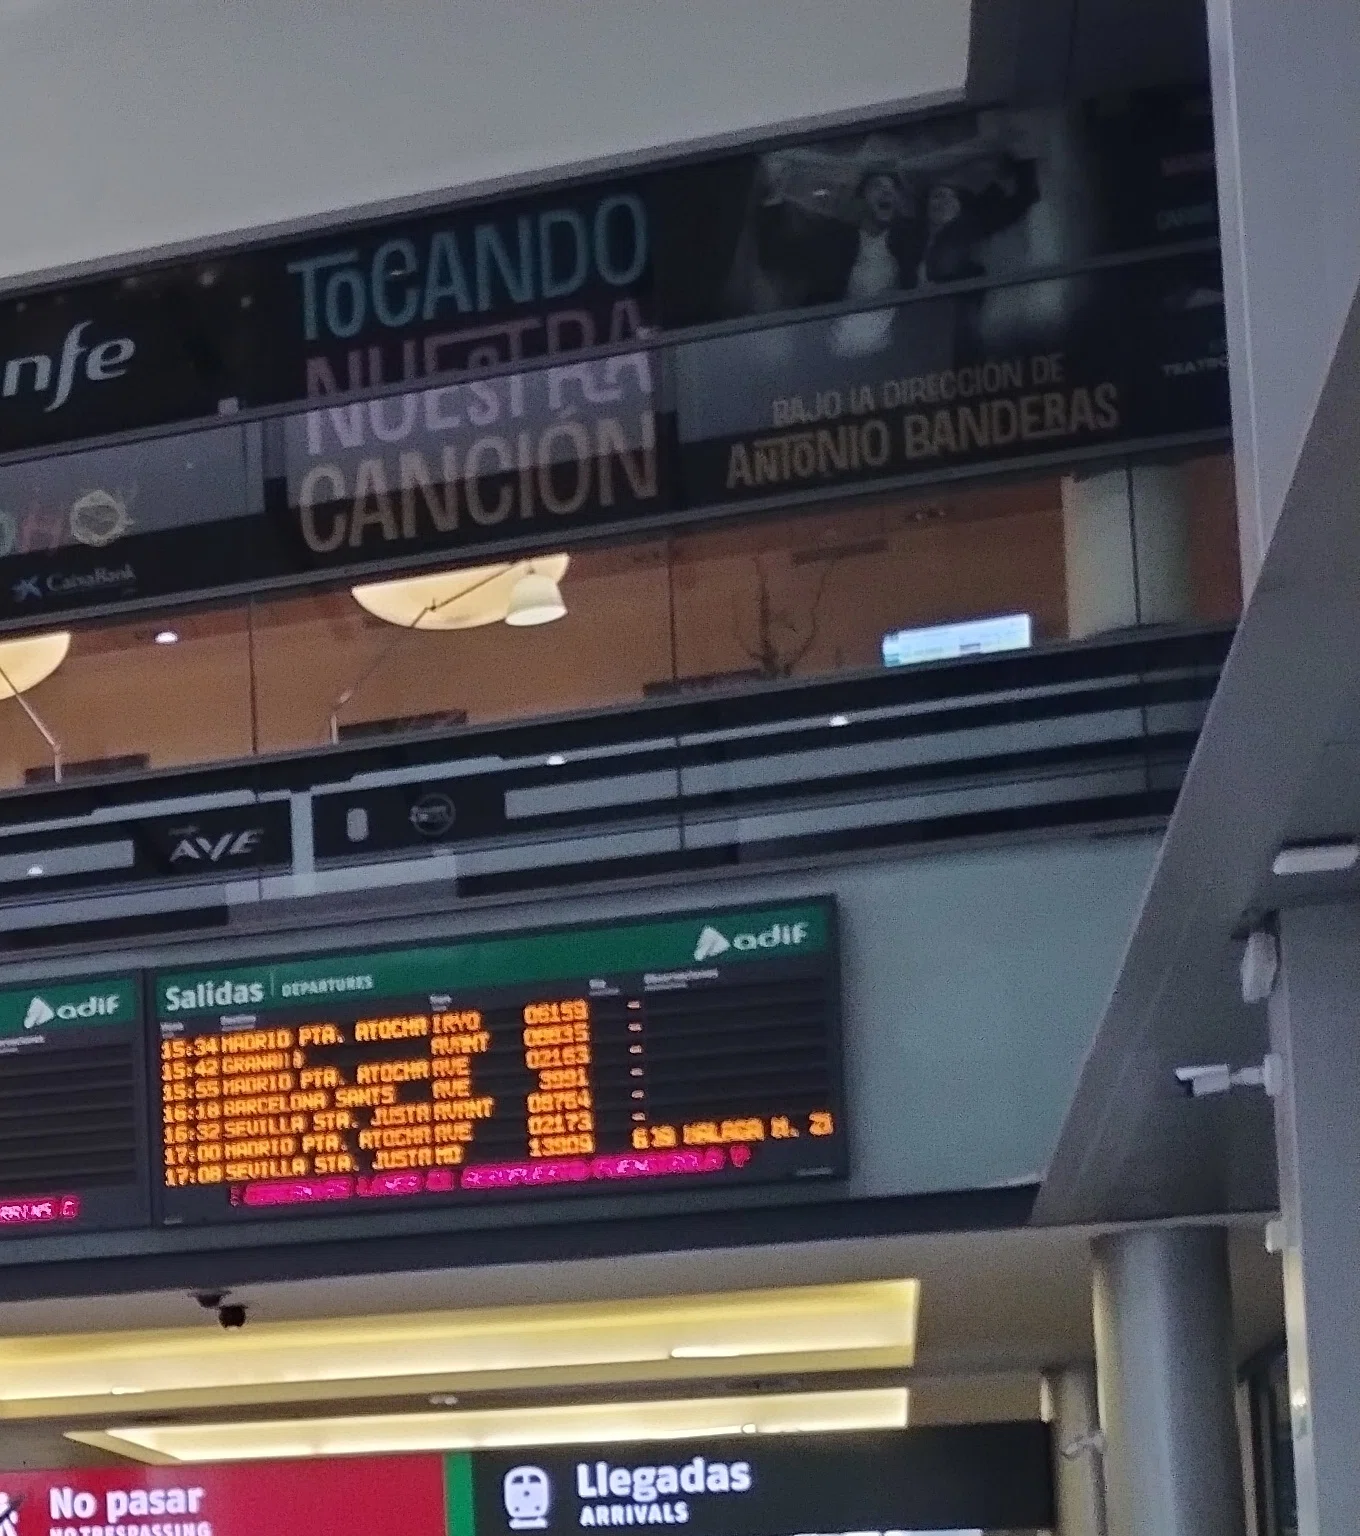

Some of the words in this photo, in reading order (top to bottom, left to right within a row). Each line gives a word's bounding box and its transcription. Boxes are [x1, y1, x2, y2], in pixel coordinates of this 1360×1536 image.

[287, 194, 648, 340] TOCANDO
[306, 297, 652, 455] NUESTRA
[773, 392, 841, 427] BAJO
[851, 385, 874, 415] LA
[1032, 353, 1065, 384] DE
[726, 420, 891, 489] ANTONIO
[903, 383, 1119, 460] BANDERAS
[300, 406, 658, 552] CANCIÓN
[171, 828, 263, 863] AVE
[733, 923, 808, 950] adif
[57, 995, 120, 1019] adif
[166, 981, 264, 1010] Salidas
[282, 975, 373, 998] DEPARTURES
[223, 1075, 292, 1095] MADRID
[357, 1061, 429, 1084] ATOCHA
[576, 1457, 752, 1502] Llegadas
[49, 1486, 95, 1520] No
[107, 1485, 205, 1523] pasar
[580, 1501, 689, 1526] ARRIVALS
